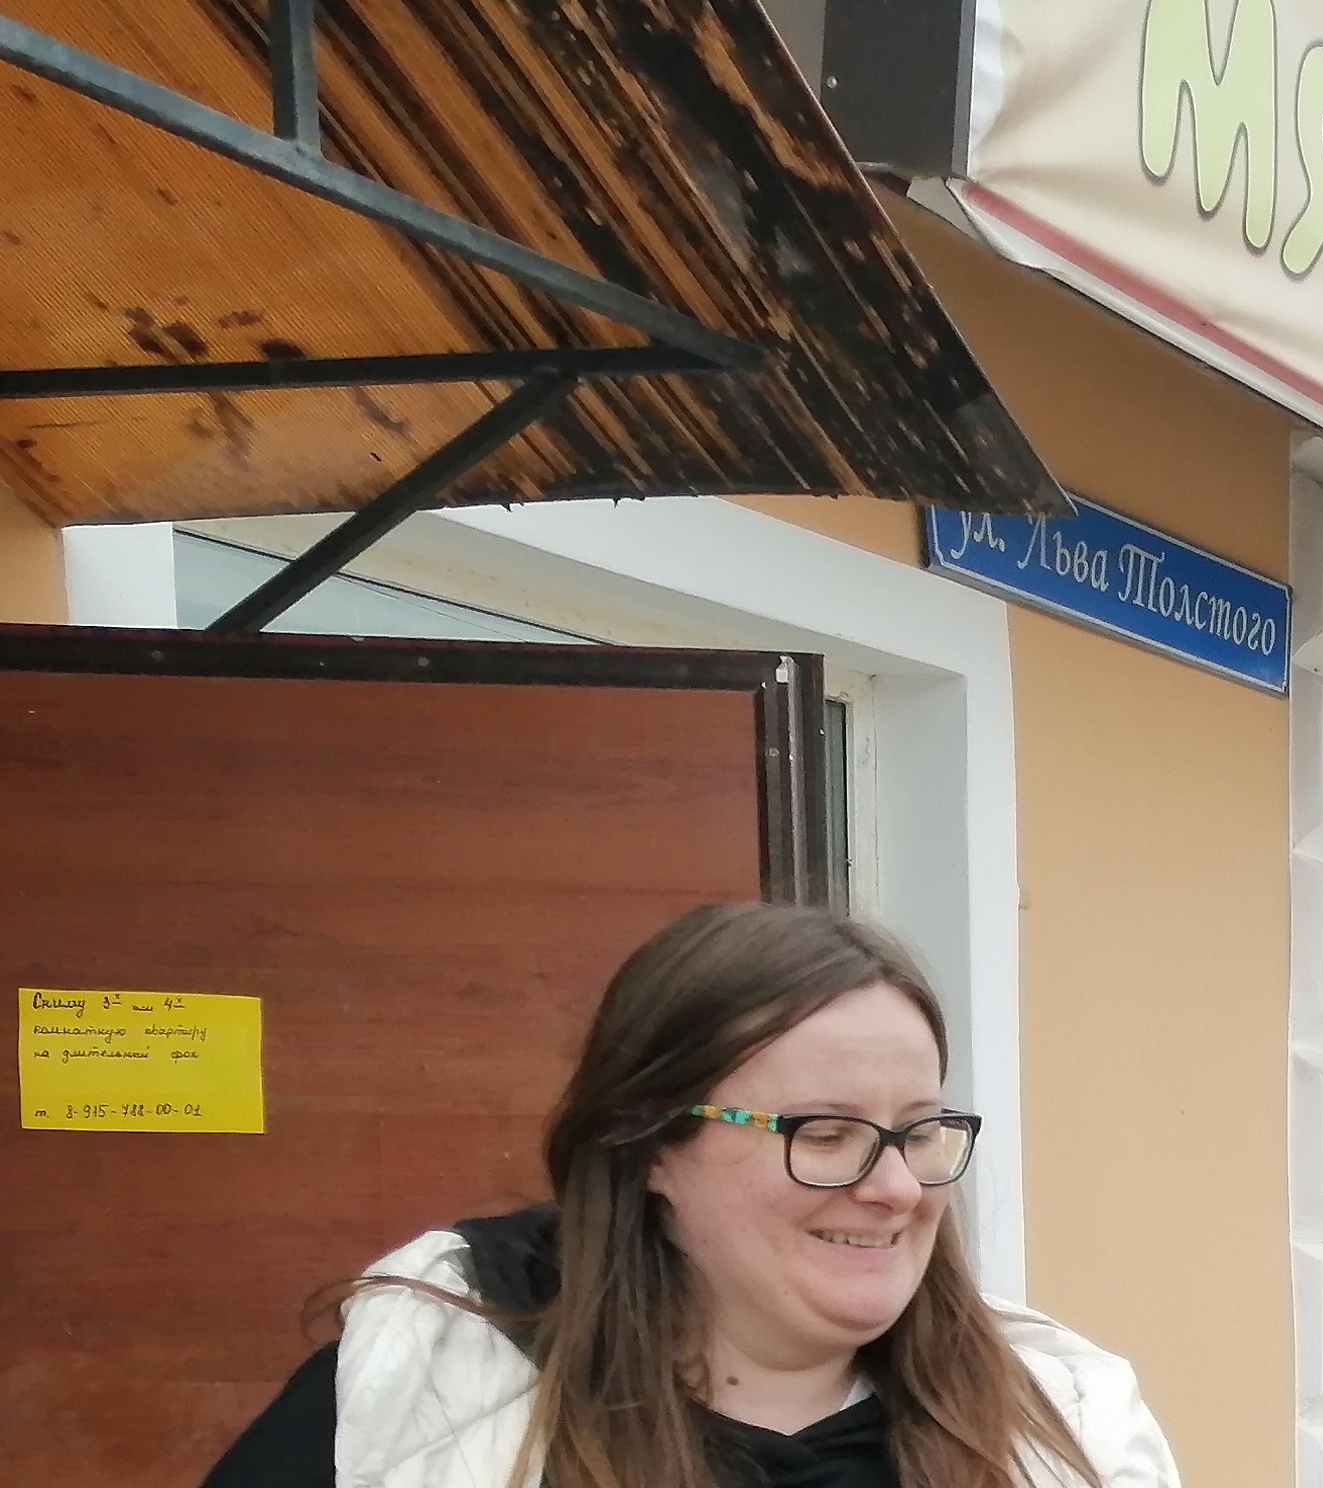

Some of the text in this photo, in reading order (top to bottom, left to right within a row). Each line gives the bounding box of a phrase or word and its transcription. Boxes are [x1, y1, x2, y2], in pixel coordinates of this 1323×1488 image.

[1017, 514, 1110, 593] Льва
[1117, 543, 1276, 656] Толстого
[32, 991, 86, 1018] Сниму
[144, 1023, 207, 1041] квартиру
[33, 1050, 50, 1059] на
